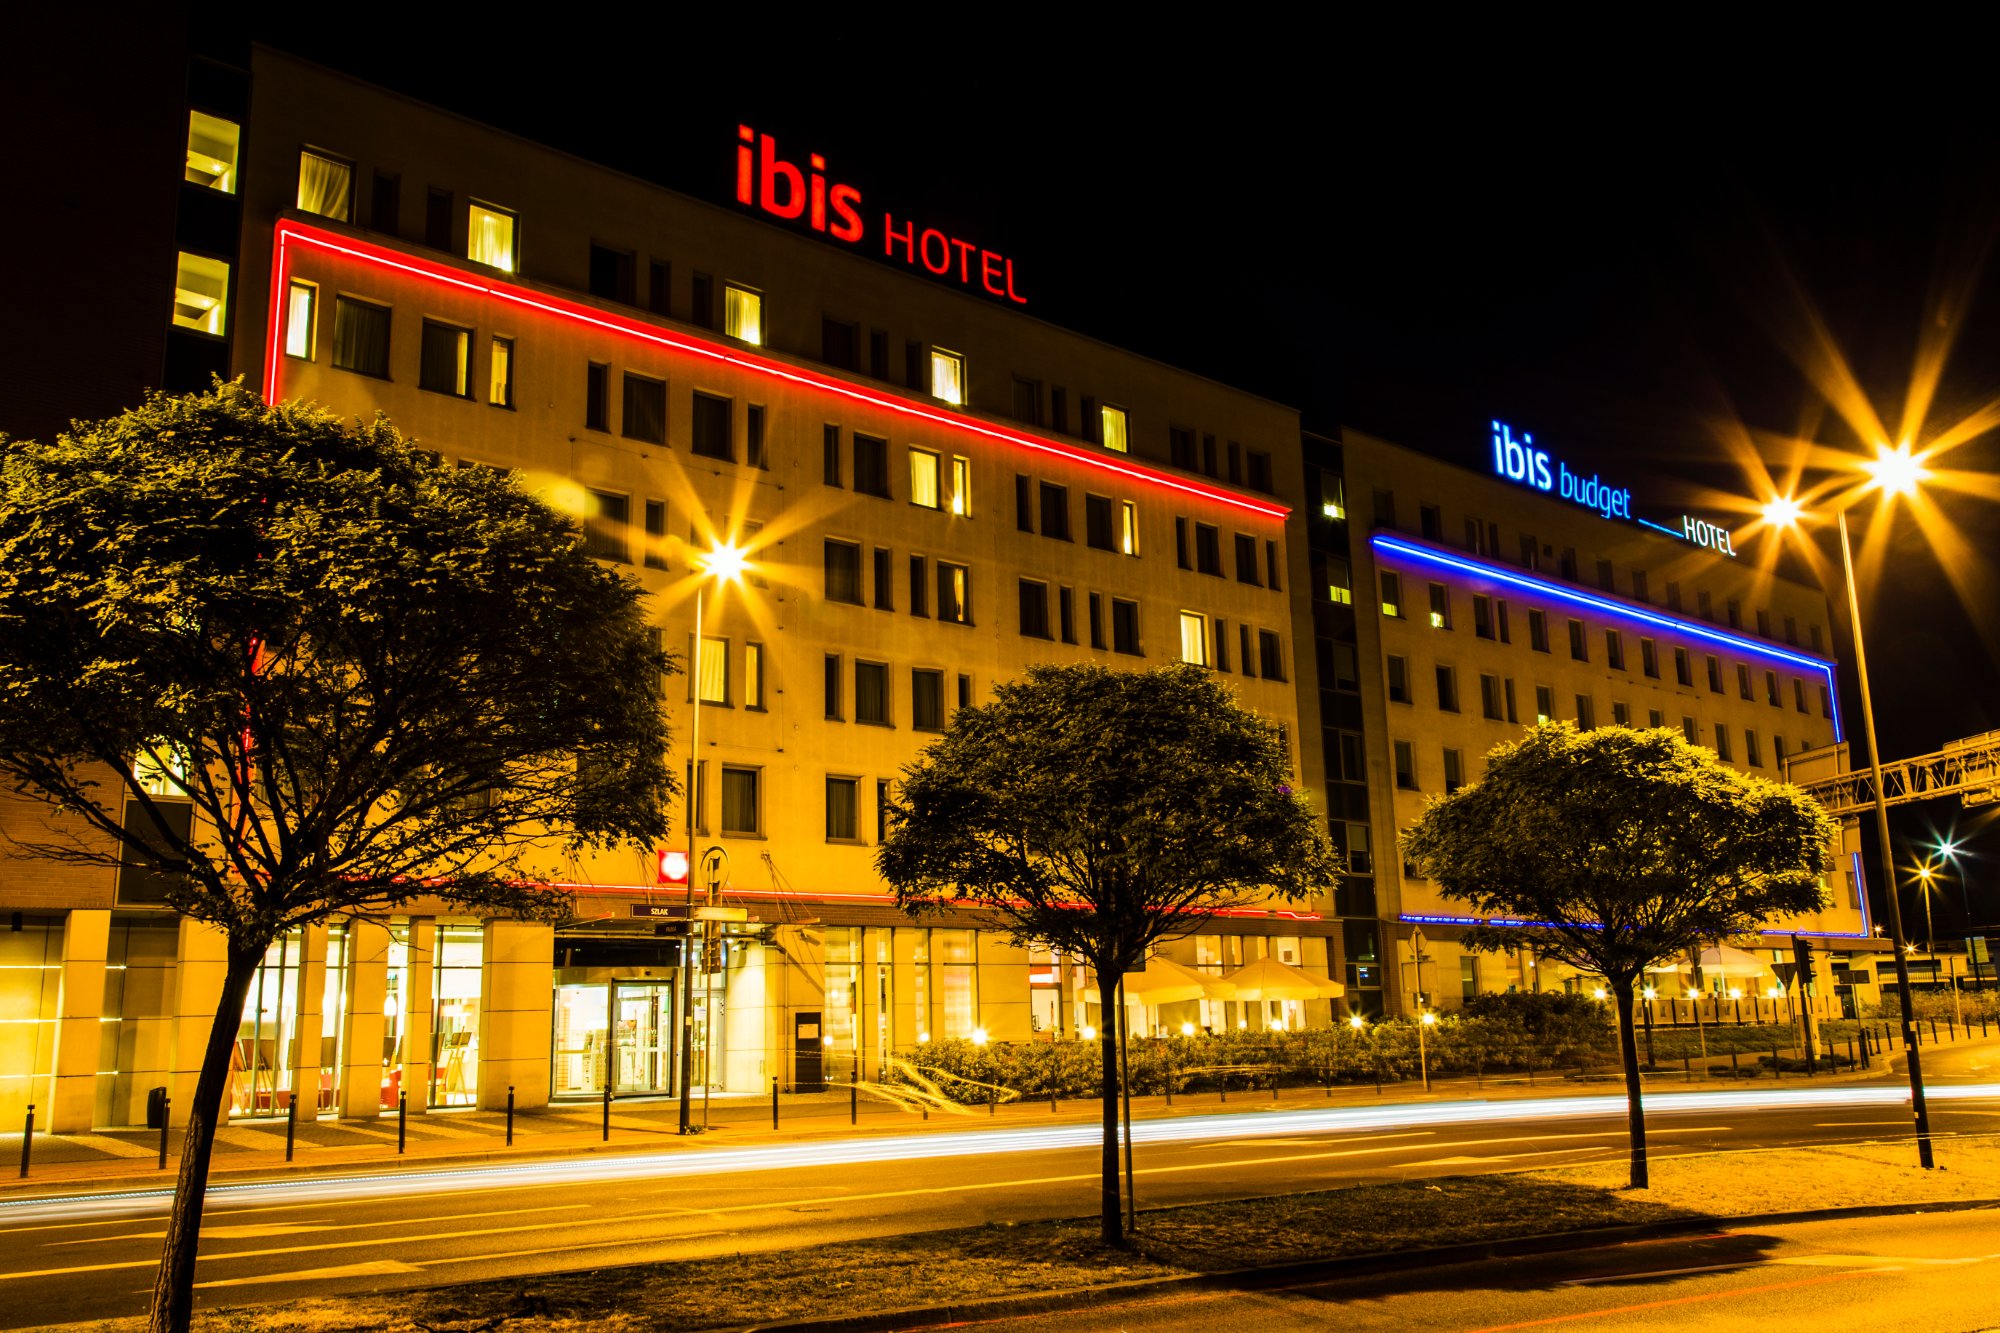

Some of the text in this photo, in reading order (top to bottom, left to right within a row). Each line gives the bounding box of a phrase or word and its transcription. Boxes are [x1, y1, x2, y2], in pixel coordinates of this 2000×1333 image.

[737, 124, 1027, 304] ibis HOTEL
[1491, 420, 1736, 556] ibis budget HOTEL
[651, 907, 668, 916] SZLAK
